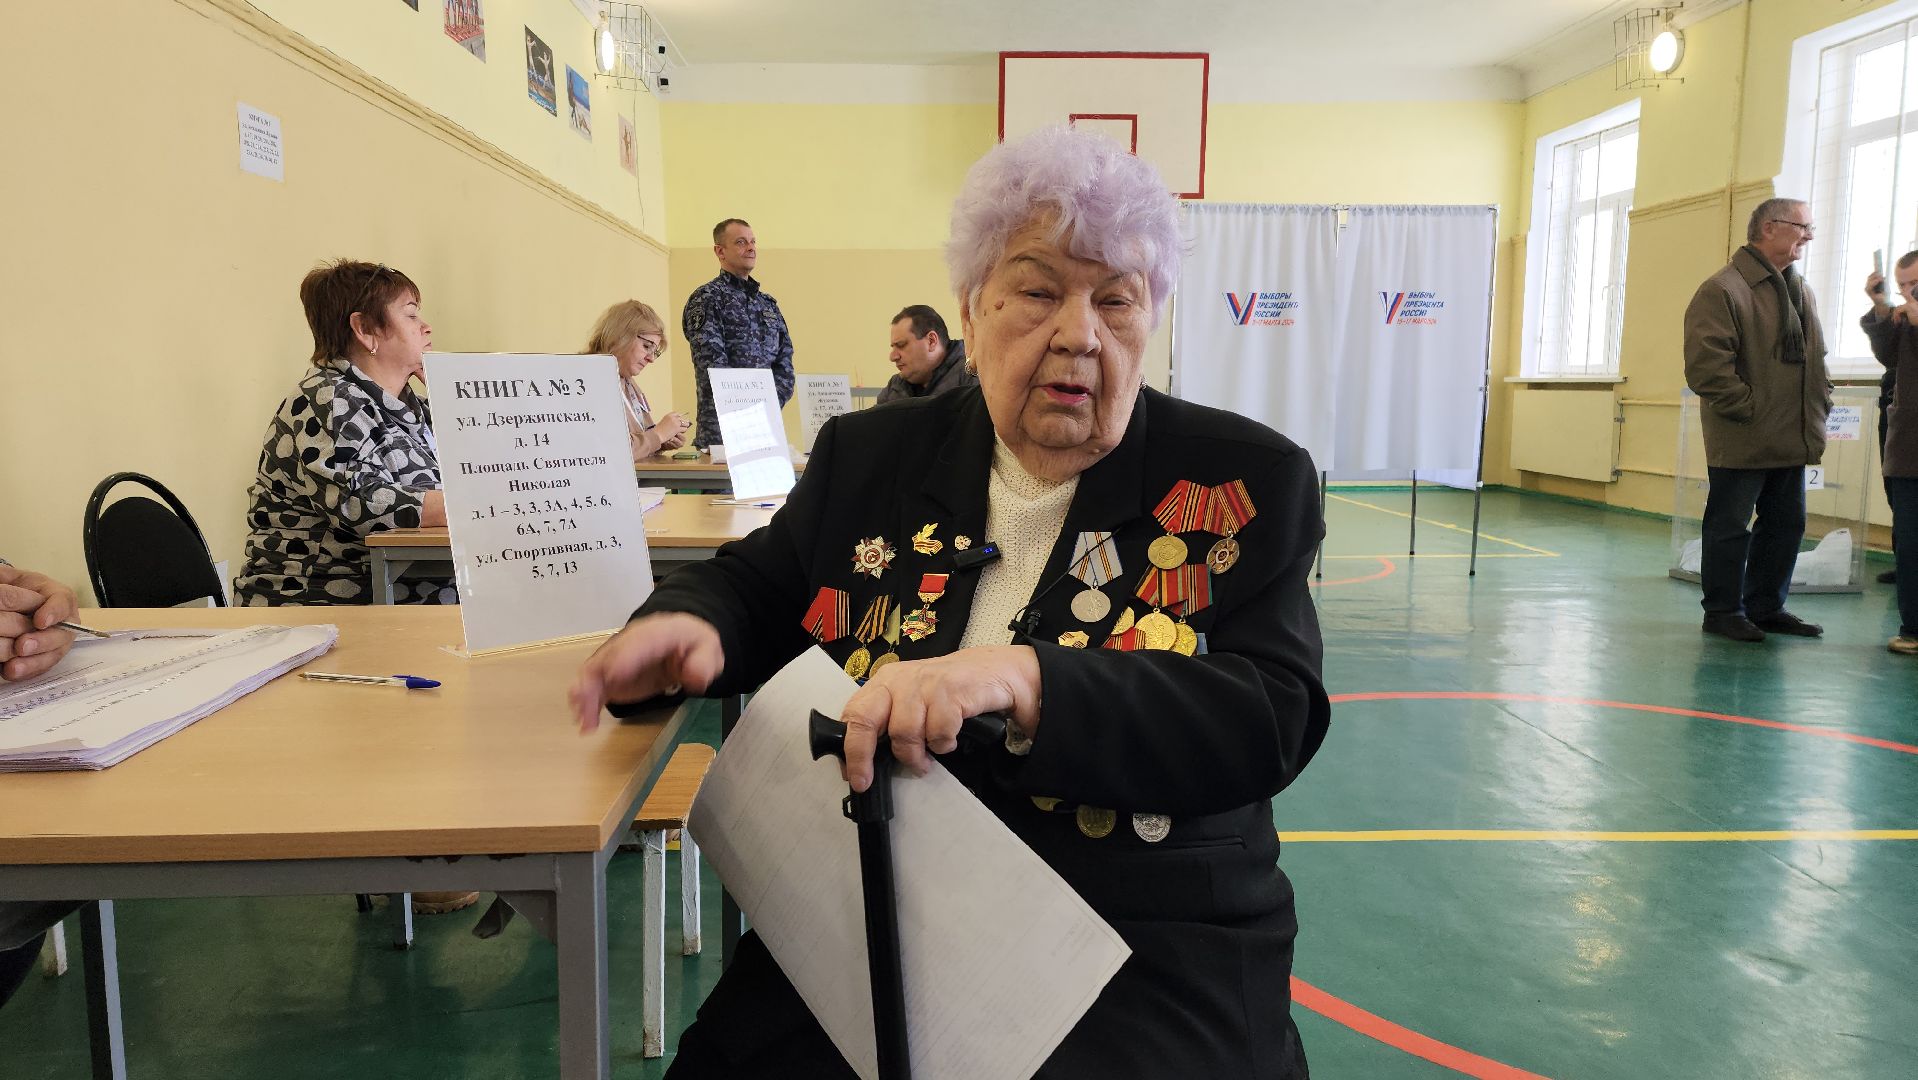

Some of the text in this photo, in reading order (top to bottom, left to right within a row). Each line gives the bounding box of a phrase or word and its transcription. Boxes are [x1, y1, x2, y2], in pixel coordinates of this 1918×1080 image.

[1259, 292, 1292, 300] ВЫБОРЫ
[455, 379, 543, 399] КНИГА
[575, 378, 586, 396] 3
[456, 411, 596, 431] ул. Дзержинская,
[514, 432, 550, 450] д. 14
[460, 456, 607, 475] Площадь Святителя
[508, 478, 571, 492] Николая
[1809, 469, 1819, 485] 2
[488, 505, 496, 518] 1
[512, 503, 526, 516] 3,
[570, 497, 583, 511] 4,
[600, 494, 612, 508] 6,
[475, 554, 498, 568] ул.
[595, 540, 608, 551] д.
[531, 561, 578, 579] 5, 7, 13
